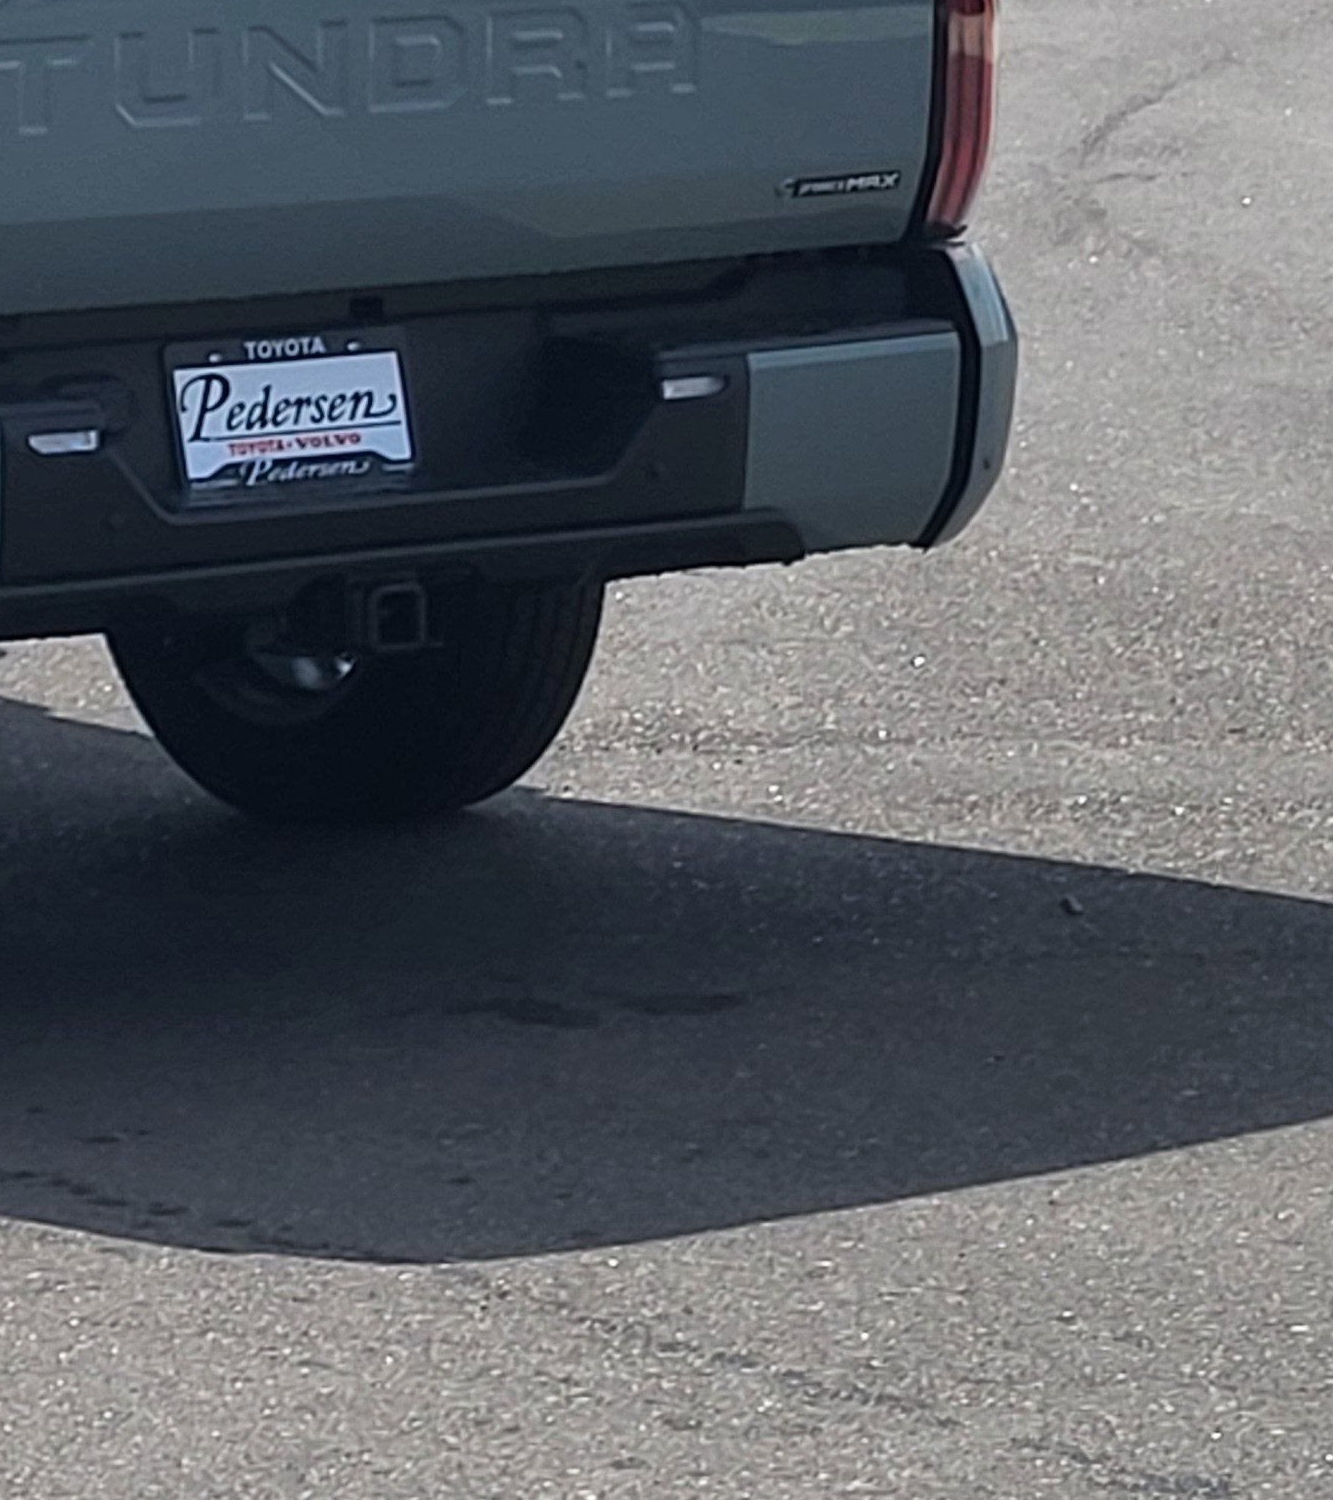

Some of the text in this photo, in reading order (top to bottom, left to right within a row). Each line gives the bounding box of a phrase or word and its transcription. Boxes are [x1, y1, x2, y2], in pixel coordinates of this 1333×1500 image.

[243, 335, 327, 361] TOYOTA
[180, 372, 398, 443] Pedersen
[238, 457, 371, 486] Pedersen
